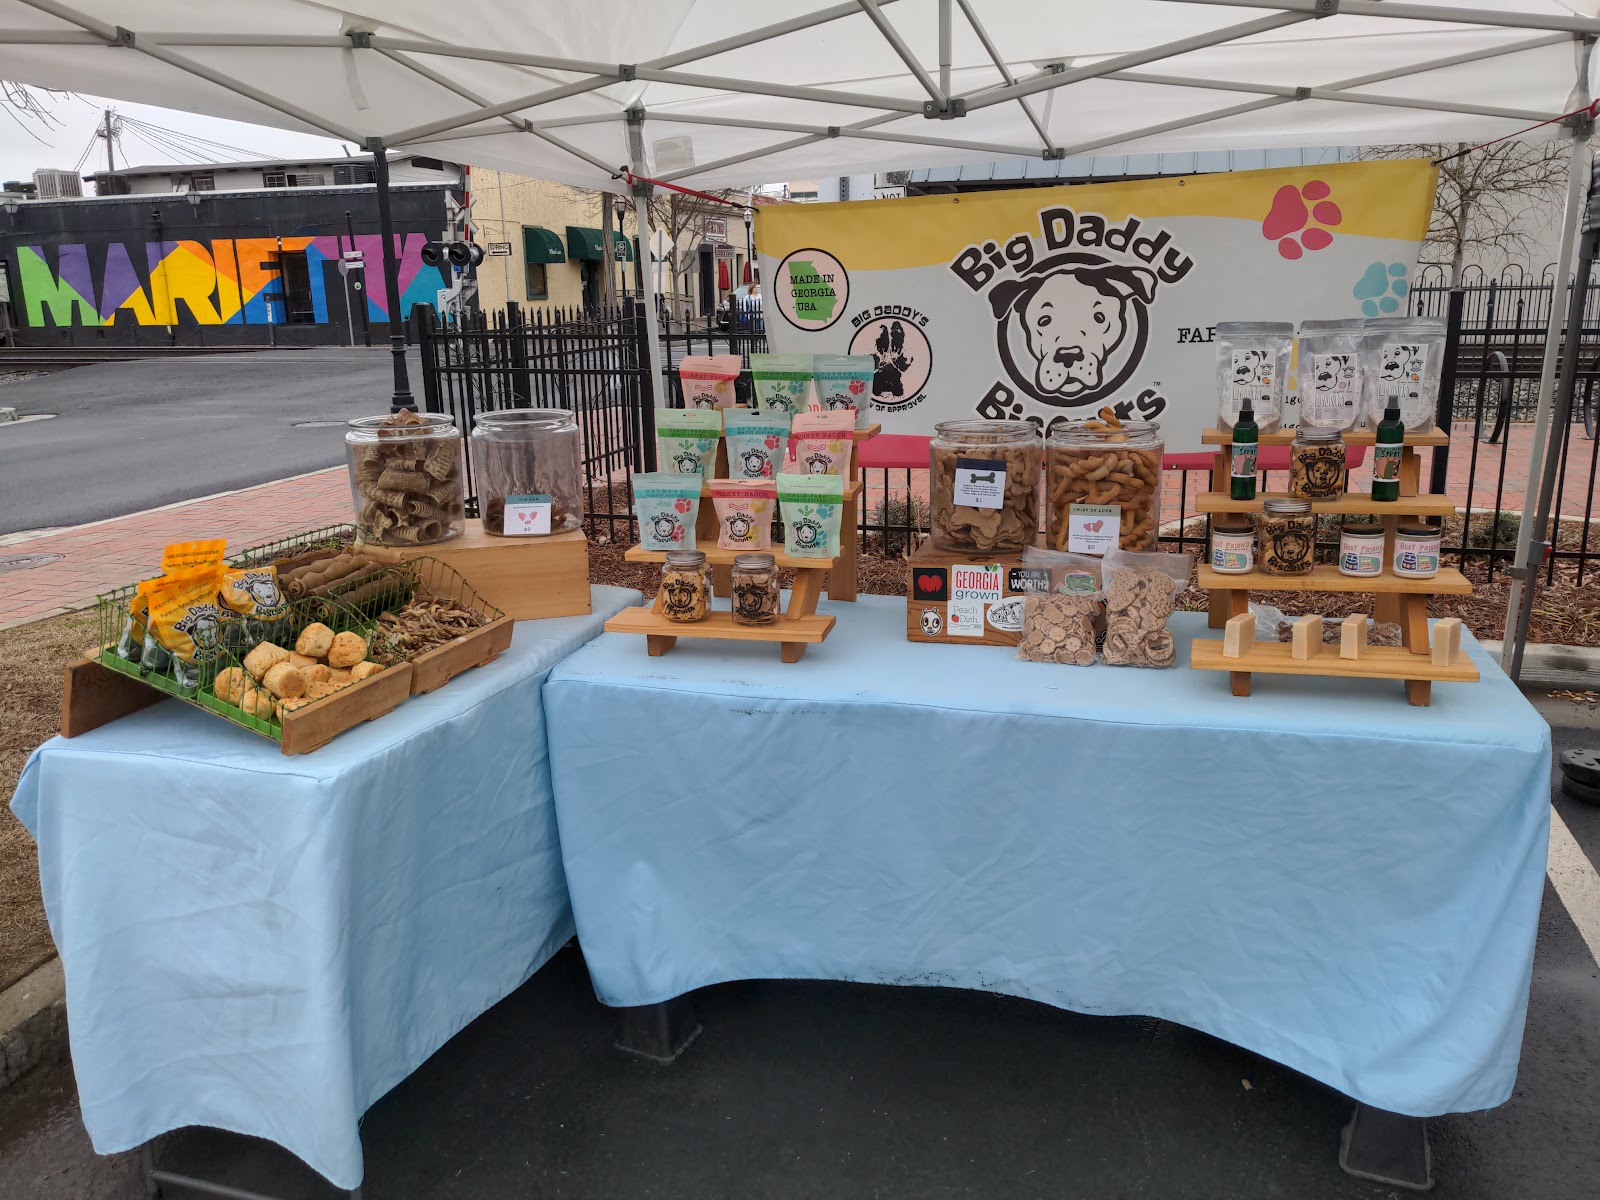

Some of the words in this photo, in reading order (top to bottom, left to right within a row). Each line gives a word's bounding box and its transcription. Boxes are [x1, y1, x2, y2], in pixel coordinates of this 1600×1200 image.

[489, 243, 509, 251] SPRING
[950, 235, 1034, 292] Big
[1040, 207, 1195, 284] Daddy
[16, 232, 453, 328] MARIETTA
[789, 274, 820, 285] MADE
[822, 273, 835, 284] IN
[791, 287, 837, 298] GEORGIA
[797, 302, 817, 312] USA
[851, 309, 872, 328] BIG
[775, 393, 793, 404] Daddy
[875, 403, 887, 412] OF
[672, 453, 683, 462] Big
[683, 451, 701, 462] Daddy
[740, 451, 751, 459] Big
[750, 448, 769, 459] Daddy
[805, 455, 814, 463] Big
[814, 452, 833, 463] Daddy
[1297, 452, 1316, 464] Big
[650, 514, 660, 522] Big
[660, 511, 680, 523] Daddy
[724, 514, 735, 523] Big
[736, 511, 755, 523] Daddy
[792, 520, 803, 528] Big
[802, 517, 822, 529] Daddy
[1265, 524, 1285, 536] Big
[795, 540, 820, 549] Biscuits
[1267, 555, 1312, 572] Biscuits
[1018, 570, 1029, 578] YOU
[233, 578, 249, 590] Big
[663, 582, 675, 590] Big
[675, 578, 698, 593] Daddy
[955, 570, 999, 591] GEORGIA
[955, 589, 999, 601] grown
[953, 605, 978, 615] Peach
[173, 615, 193, 632] Big
[188, 603, 219, 617] Daddy
[959, 614, 978, 624] Dish
